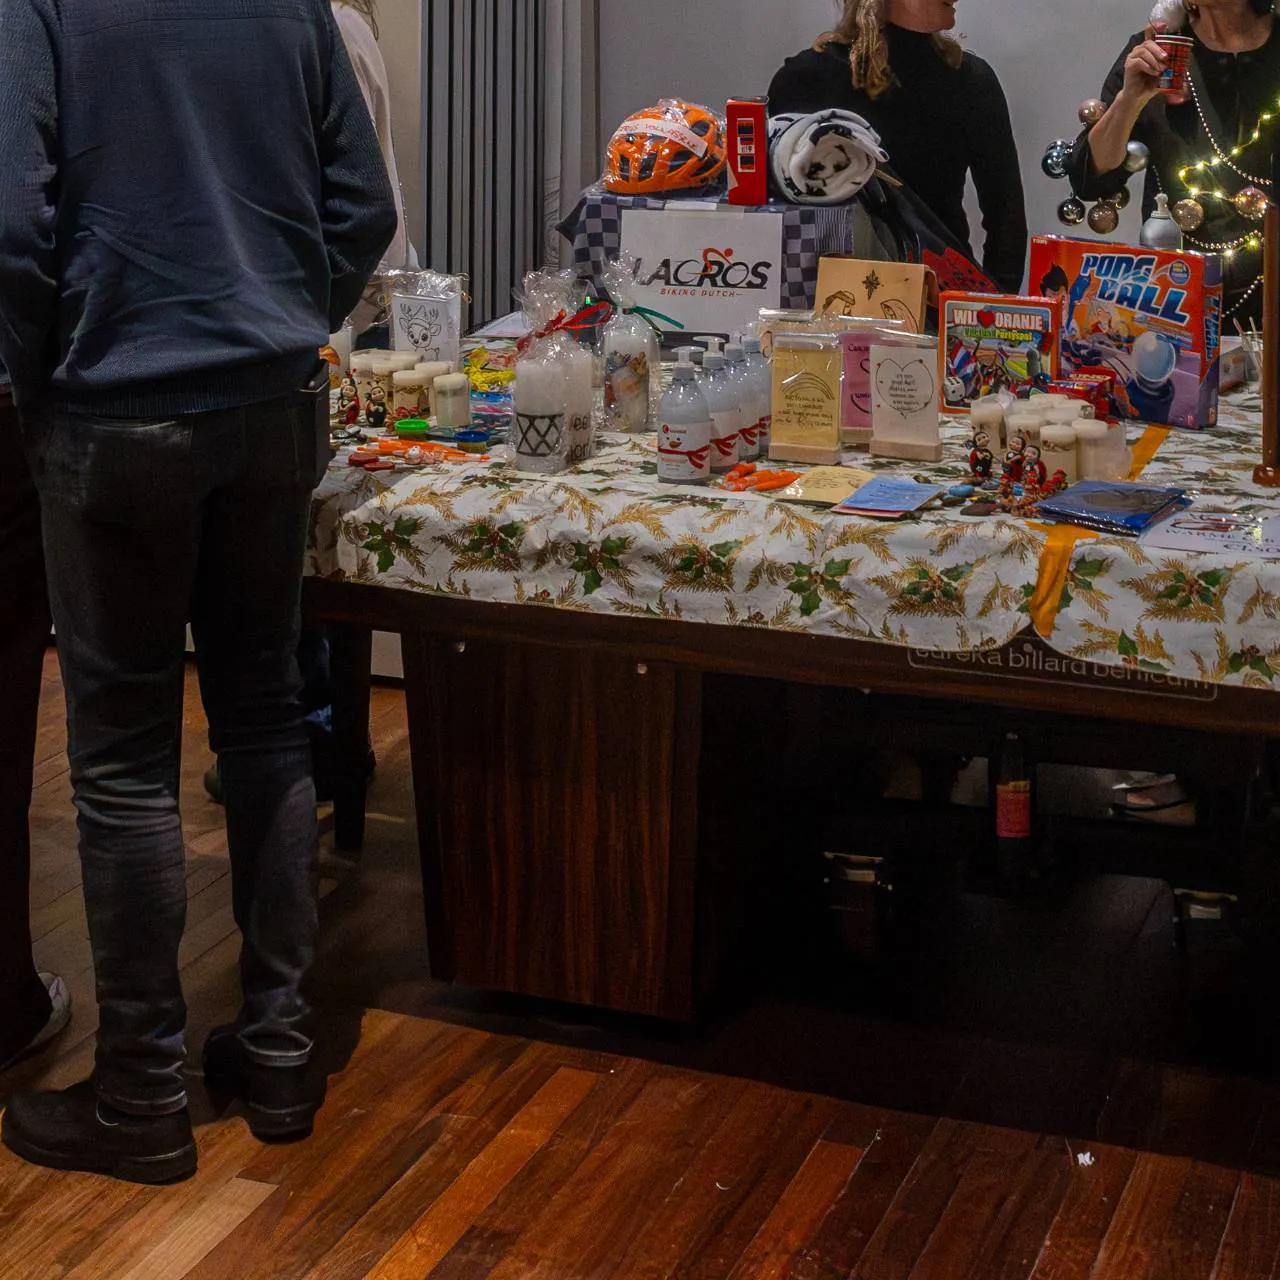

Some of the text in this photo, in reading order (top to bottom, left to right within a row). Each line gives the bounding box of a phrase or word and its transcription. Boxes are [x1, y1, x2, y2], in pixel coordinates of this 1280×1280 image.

[1080, 253, 1158, 284] PONG
[659, 288, 696, 297] BIKING
[1096, 279, 1190, 327] BALL
[953, 308, 1043, 331] WIJ ORANJE
